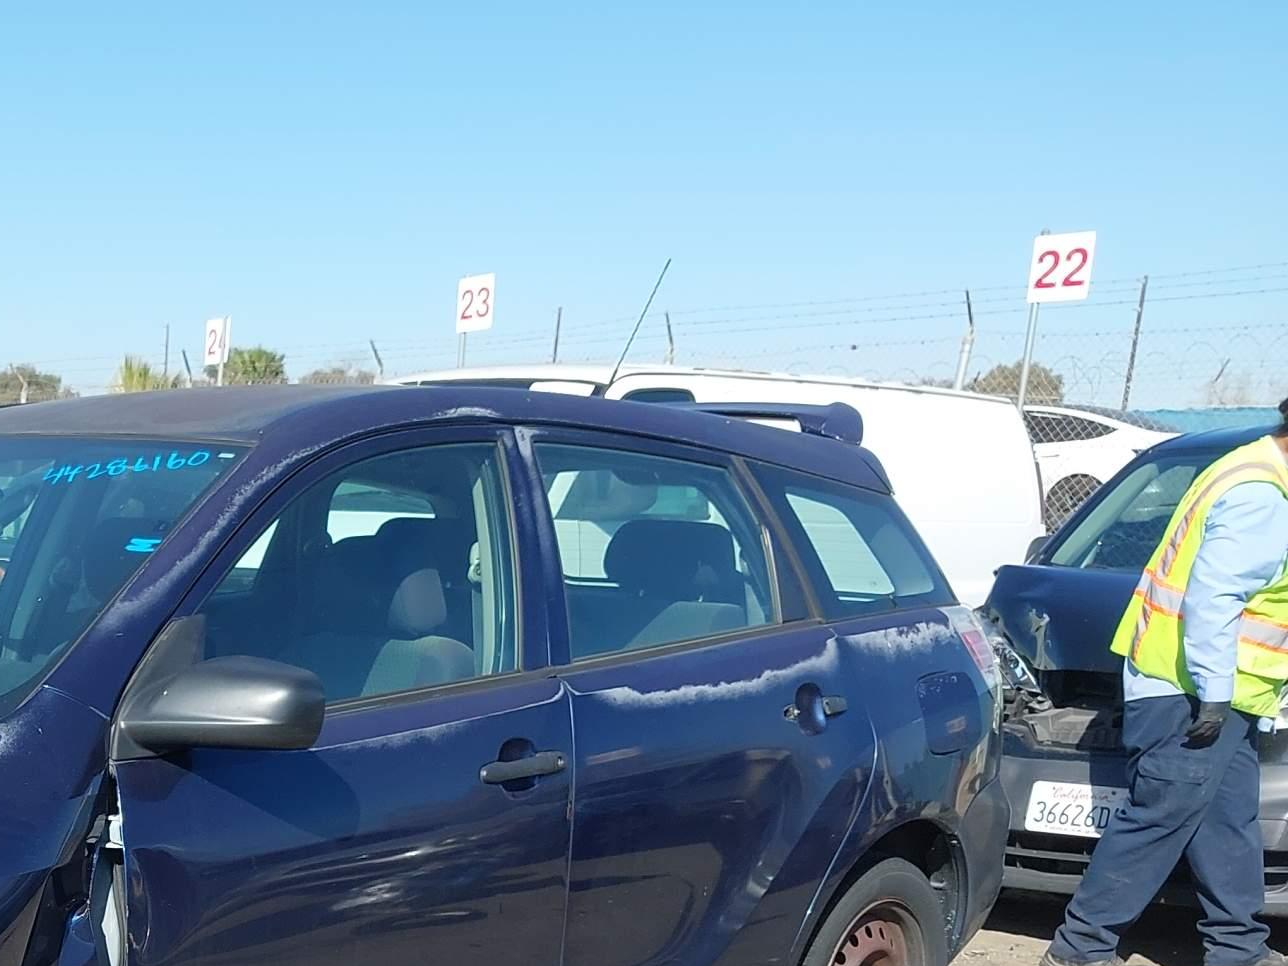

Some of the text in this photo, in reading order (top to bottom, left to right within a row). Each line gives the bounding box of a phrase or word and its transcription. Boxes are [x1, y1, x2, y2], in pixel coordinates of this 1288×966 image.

[1034, 247, 1088, 288] 22
[461, 287, 489, 319] 23
[43, 450, 210, 484] 44286160
[1033, 801, 1116, 829] 36626D
